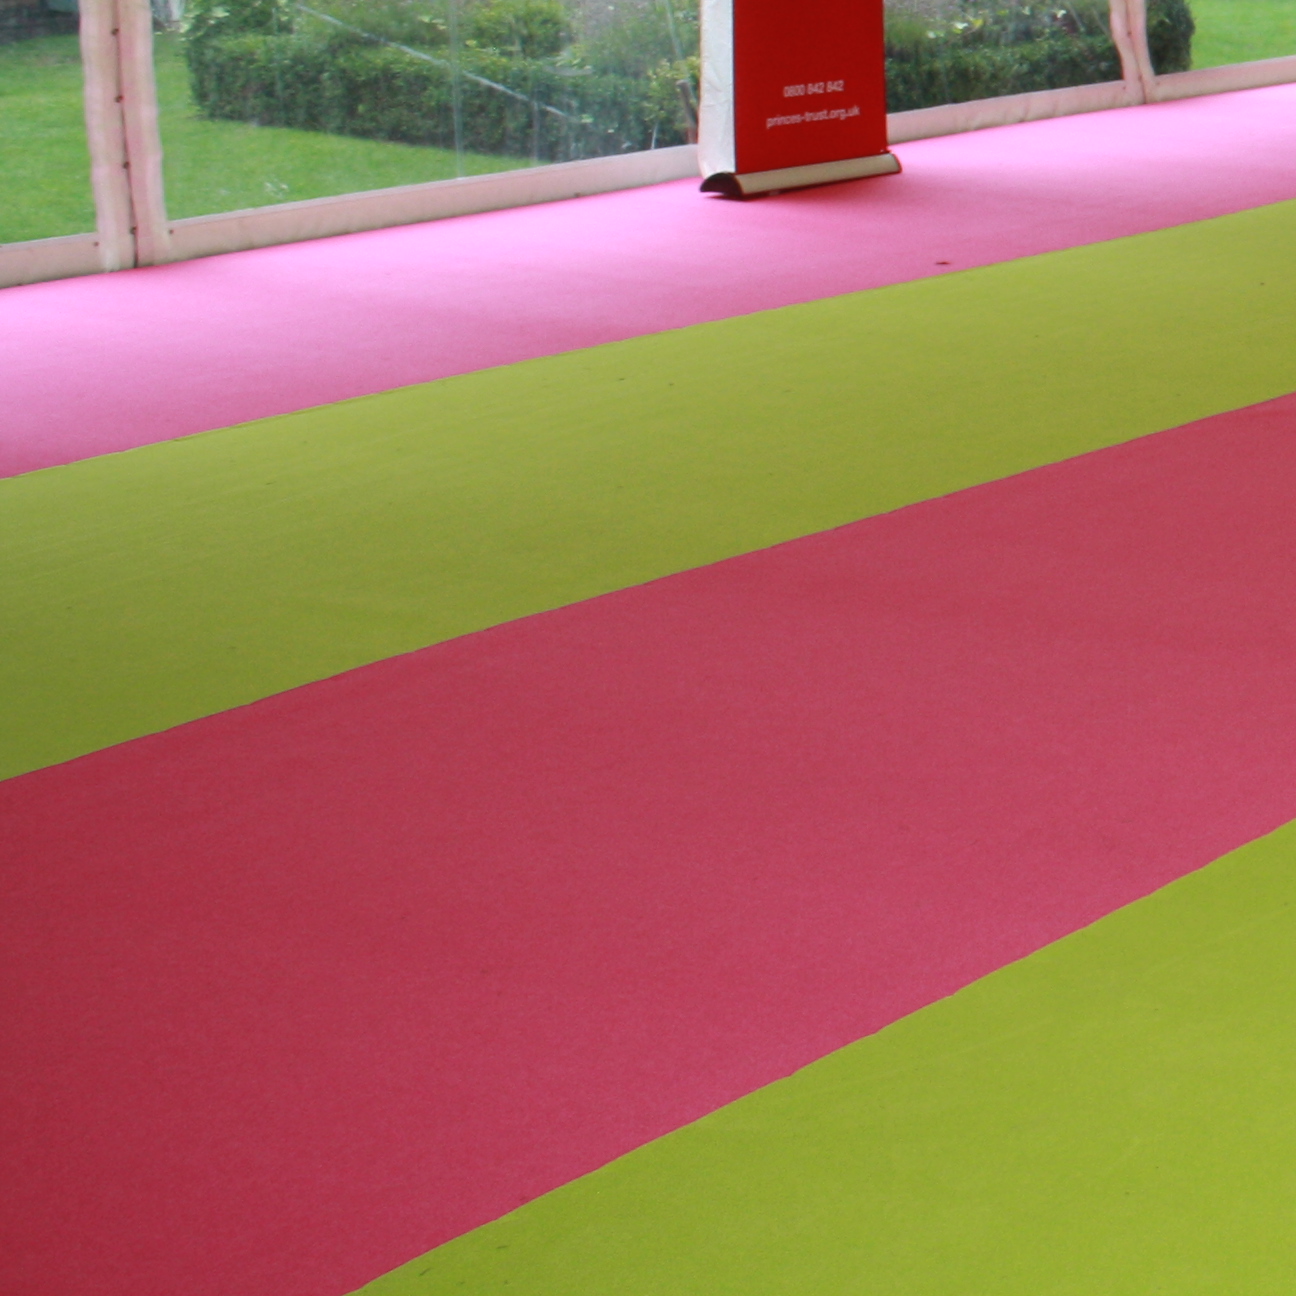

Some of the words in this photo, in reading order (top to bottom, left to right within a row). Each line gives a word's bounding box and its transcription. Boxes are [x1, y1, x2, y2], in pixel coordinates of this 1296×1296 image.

[783, 84, 806, 98] 0800
[807, 82, 825, 95] 842
[826, 80, 844, 93] 842
